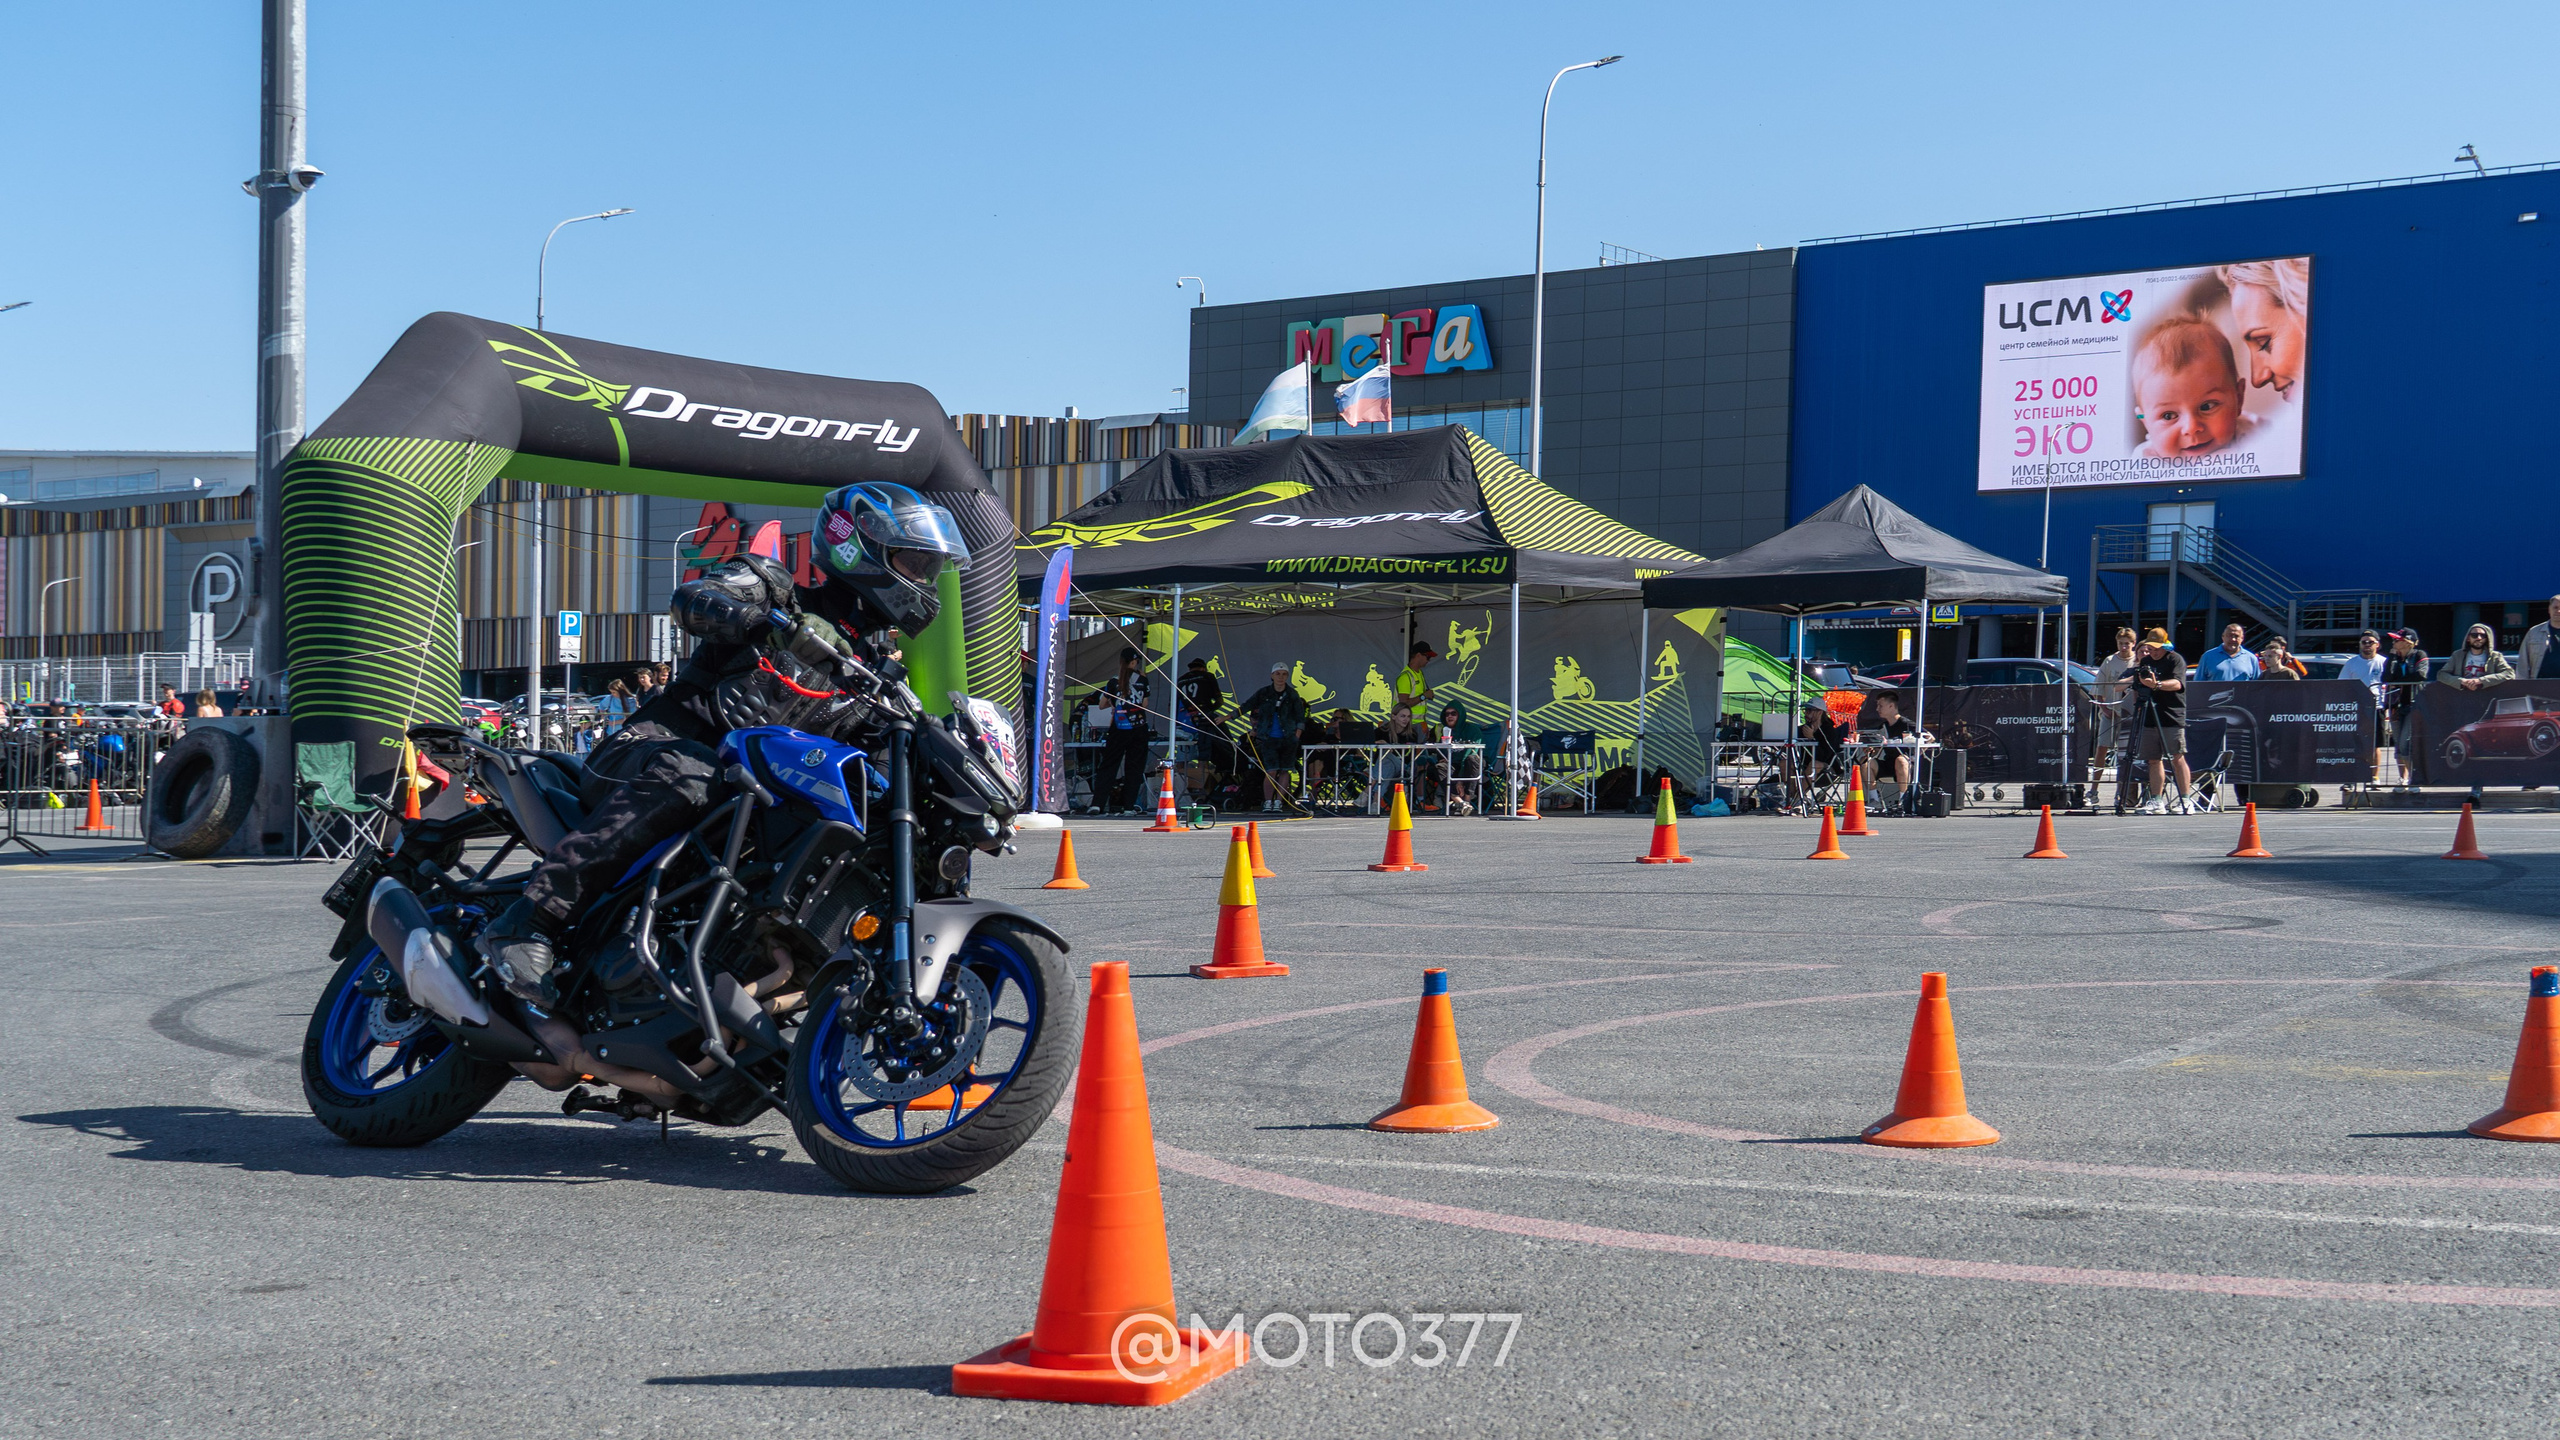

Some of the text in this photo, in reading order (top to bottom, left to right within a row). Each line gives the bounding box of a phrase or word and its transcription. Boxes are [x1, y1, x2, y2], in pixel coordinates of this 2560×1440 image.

[1998, 296, 2093, 332] ЦСМ
[1999, 335, 2119, 351] центр семейной медицины
[2014, 375, 2098, 401] 25 000
[2013, 404, 2097, 420] УСПЕШНЫХ
[2013, 422, 2094, 458] ЭКО
[2011, 452, 2256, 477] ИМЕЮТСЯ ПРОТИВОПОКАЗАНИЯ
[2011, 465, 2261, 486] НЕОБХОДИМА КОНСУЛЬТАЦИЯ СПЕЦИАЛИСТА
[828, 513, 855, 539] 55
[835, 541, 859, 565] 48
[1266, 556, 1508, 574] WWW.DRAGON-FLY.SU
[565, 614, 578, 634] P
[2046, 705, 2076, 714] МУЗЙ
[2325, 701, 2358, 711] МУЗЕЙ
[1995, 715, 2075, 724] АВТОМОБИЛЬНЙ
[2269, 712, 2357, 722] АВТОМОБИЛЬНОЙ
[2035, 726, 2075, 734] ТЕХНИИ
[2313, 724, 2357, 732] ТЕХНИКИ
[769, 761, 817, 787] MT
